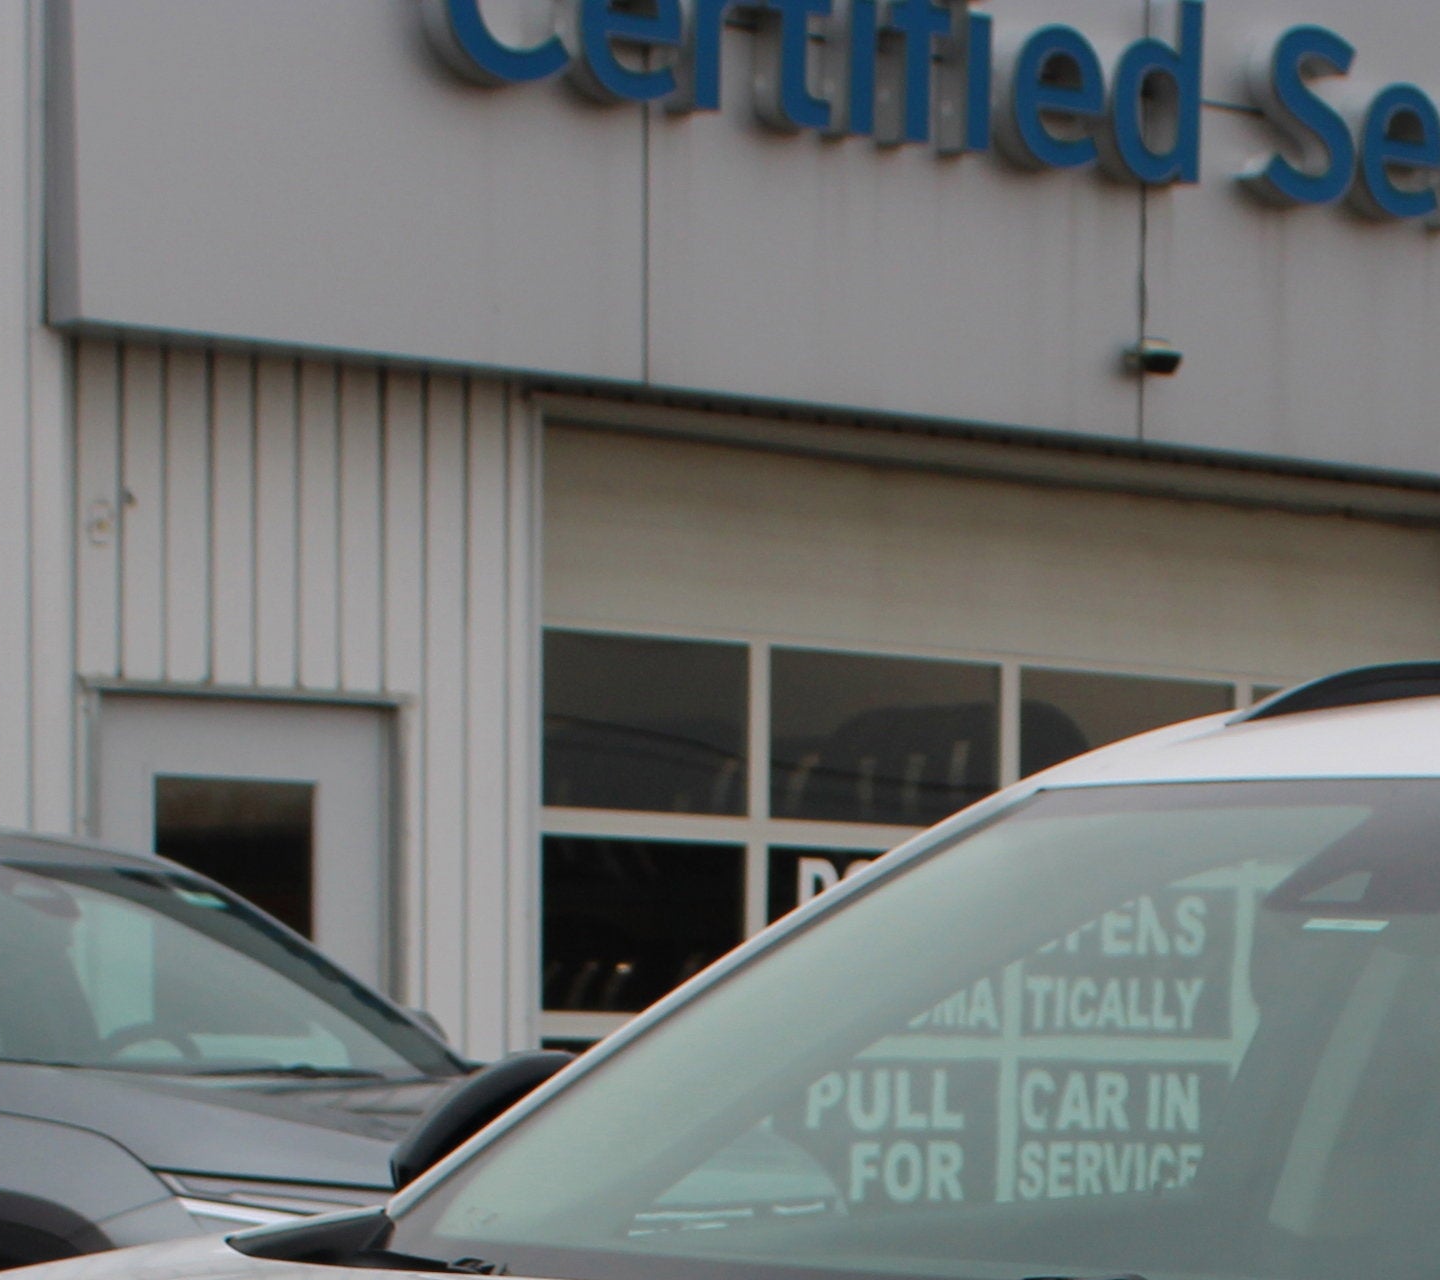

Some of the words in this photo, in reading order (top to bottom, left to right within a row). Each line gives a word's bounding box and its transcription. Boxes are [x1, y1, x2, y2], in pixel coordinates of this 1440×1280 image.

[806, 1068, 964, 1132] PULL
[1020, 1070, 1129, 1131] CAR
[1146, 1071, 1200, 1132] IN
[849, 1140, 964, 1202] FOR
